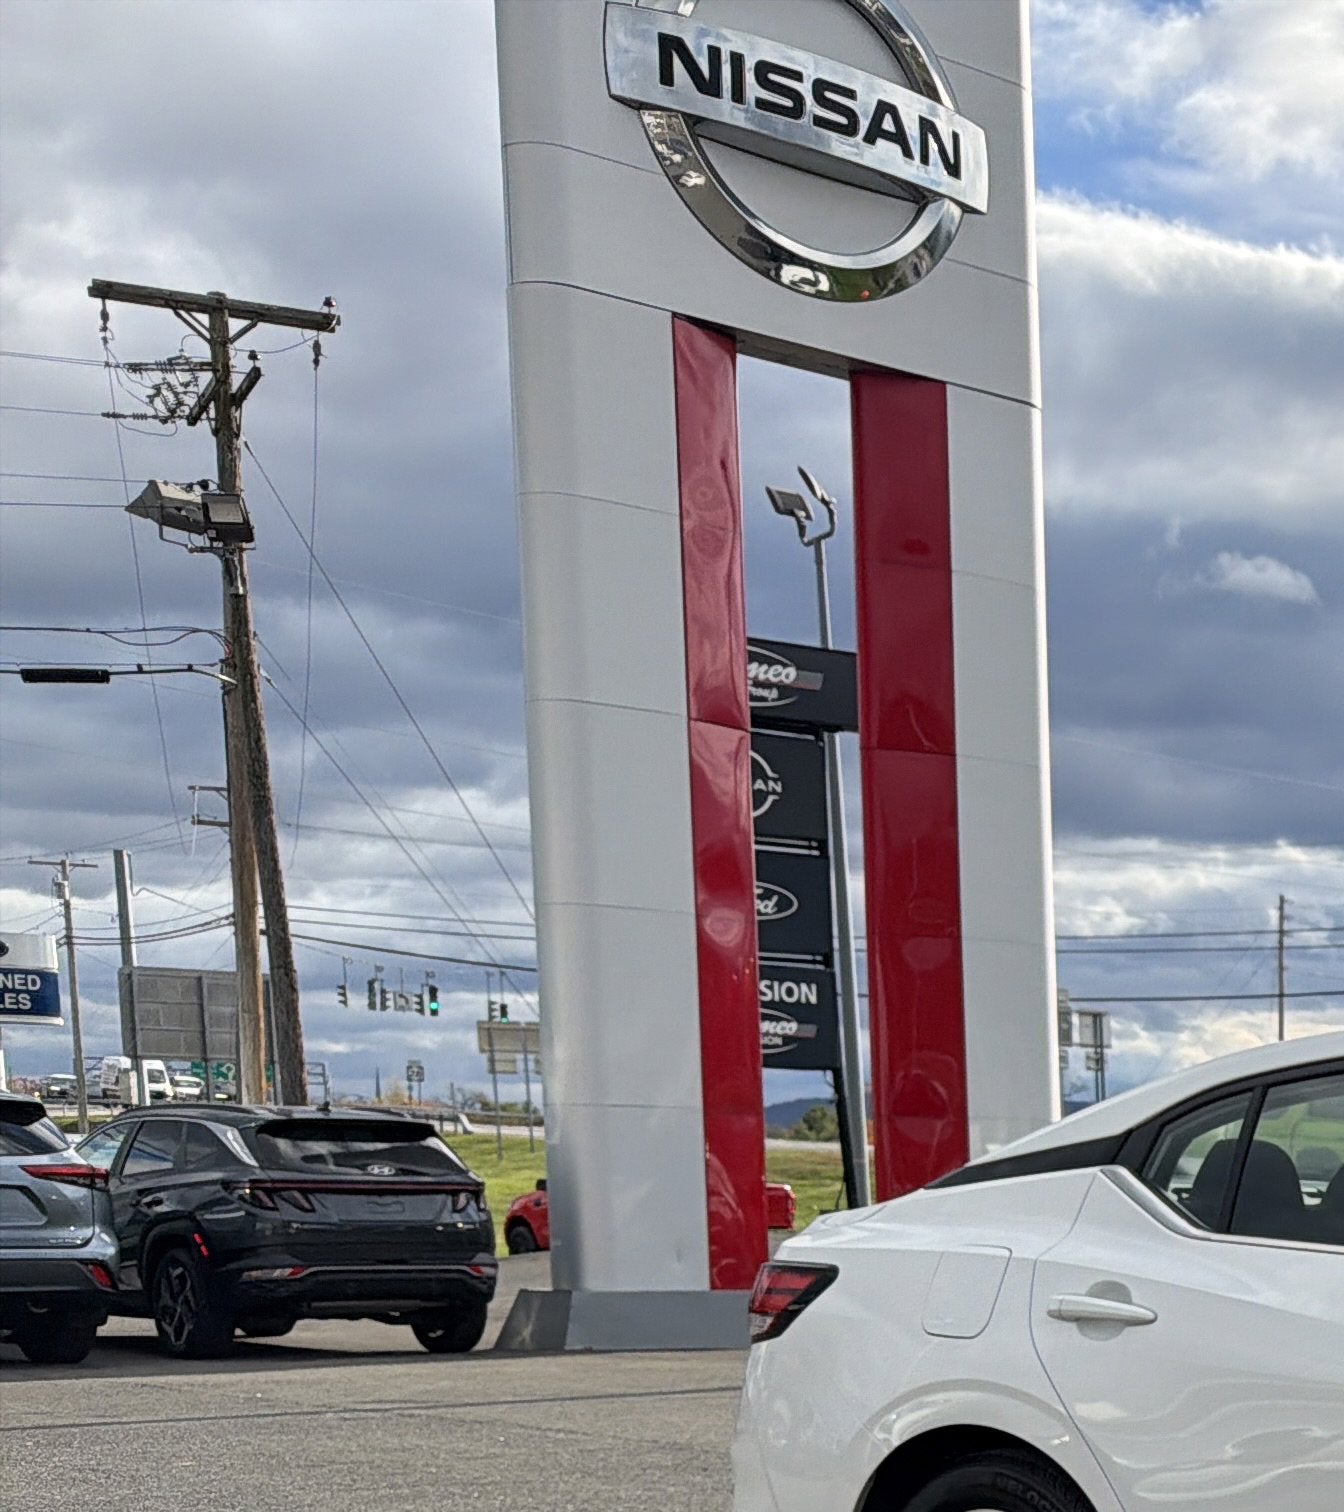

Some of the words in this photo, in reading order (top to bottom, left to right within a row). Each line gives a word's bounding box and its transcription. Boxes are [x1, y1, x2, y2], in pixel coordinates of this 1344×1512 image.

[657, 31, 962, 181] NISSAN
[0, 972, 42, 991] NED
[759, 979, 818, 1005] SION
